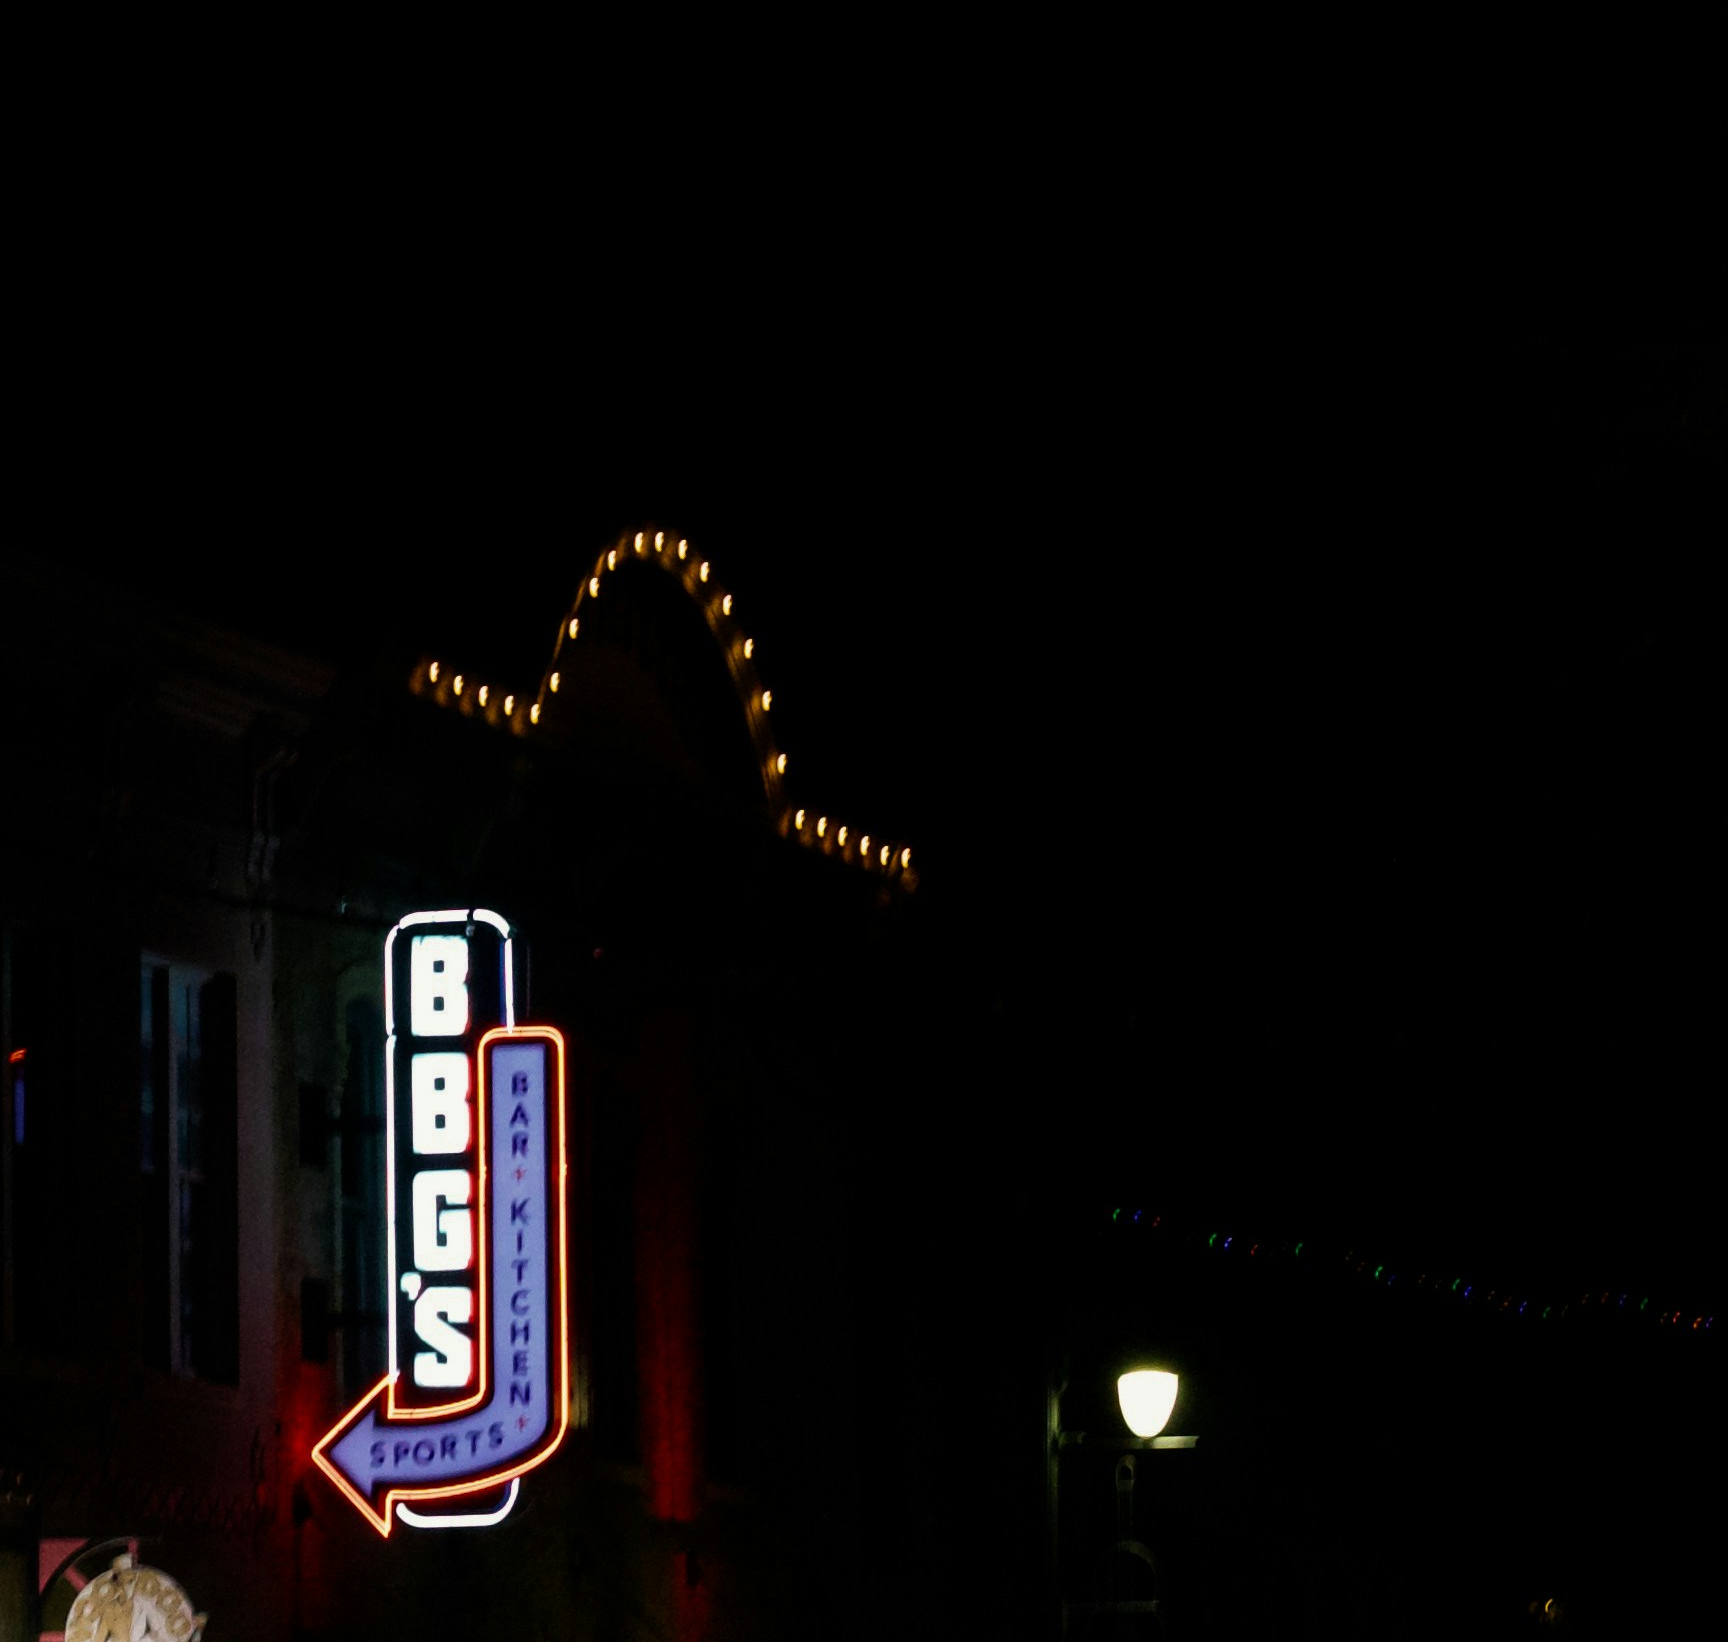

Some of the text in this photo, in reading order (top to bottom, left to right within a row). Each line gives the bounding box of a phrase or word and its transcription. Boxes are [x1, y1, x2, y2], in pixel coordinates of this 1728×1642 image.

[399, 934, 473, 1389] BBG'S
[509, 1071, 530, 1409] BAR KITCHEN
[369, 1421, 505, 1470] SPORTS
